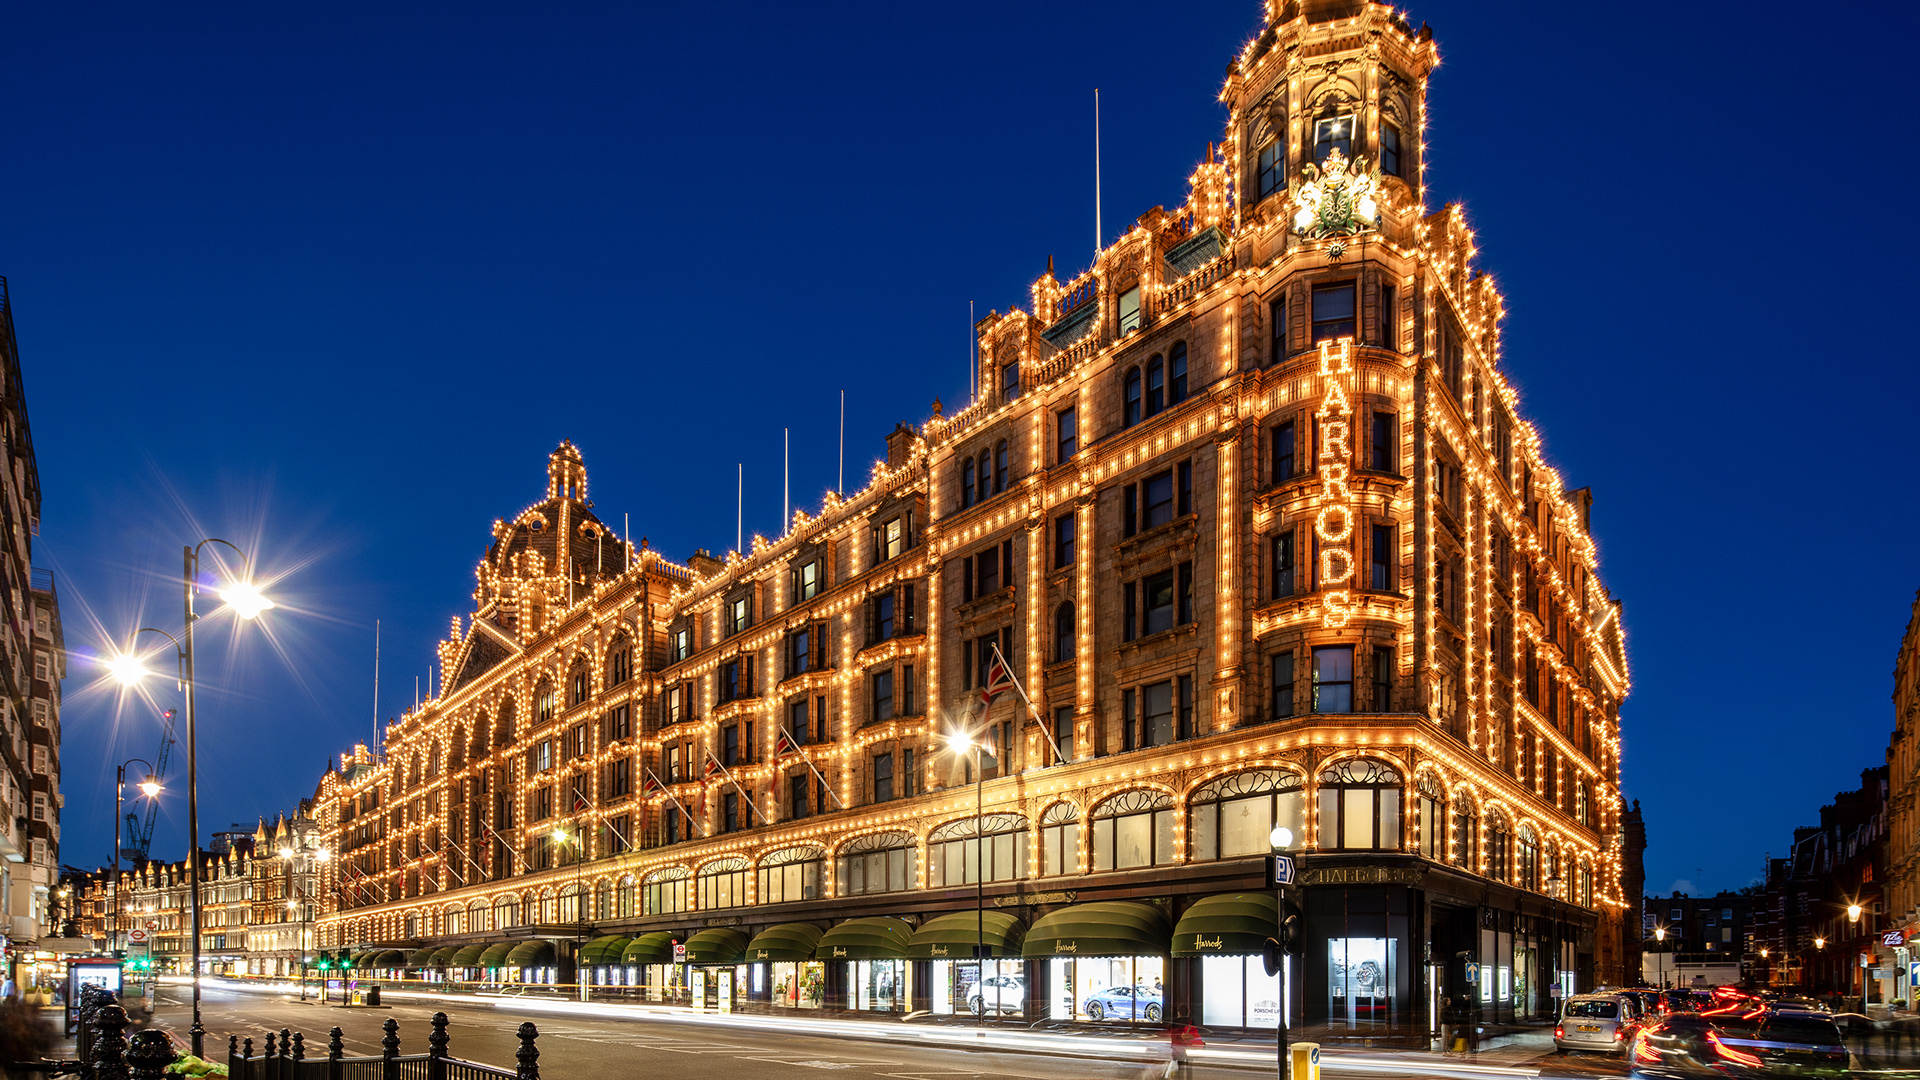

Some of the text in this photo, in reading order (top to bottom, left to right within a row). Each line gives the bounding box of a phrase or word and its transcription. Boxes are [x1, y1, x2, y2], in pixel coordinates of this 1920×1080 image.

[1316, 336, 1355, 628] HARRODS
[1277, 859, 1286, 880] P
[1054, 939, 1077, 953] Harrods
[1193, 934, 1222, 950] Harrods
